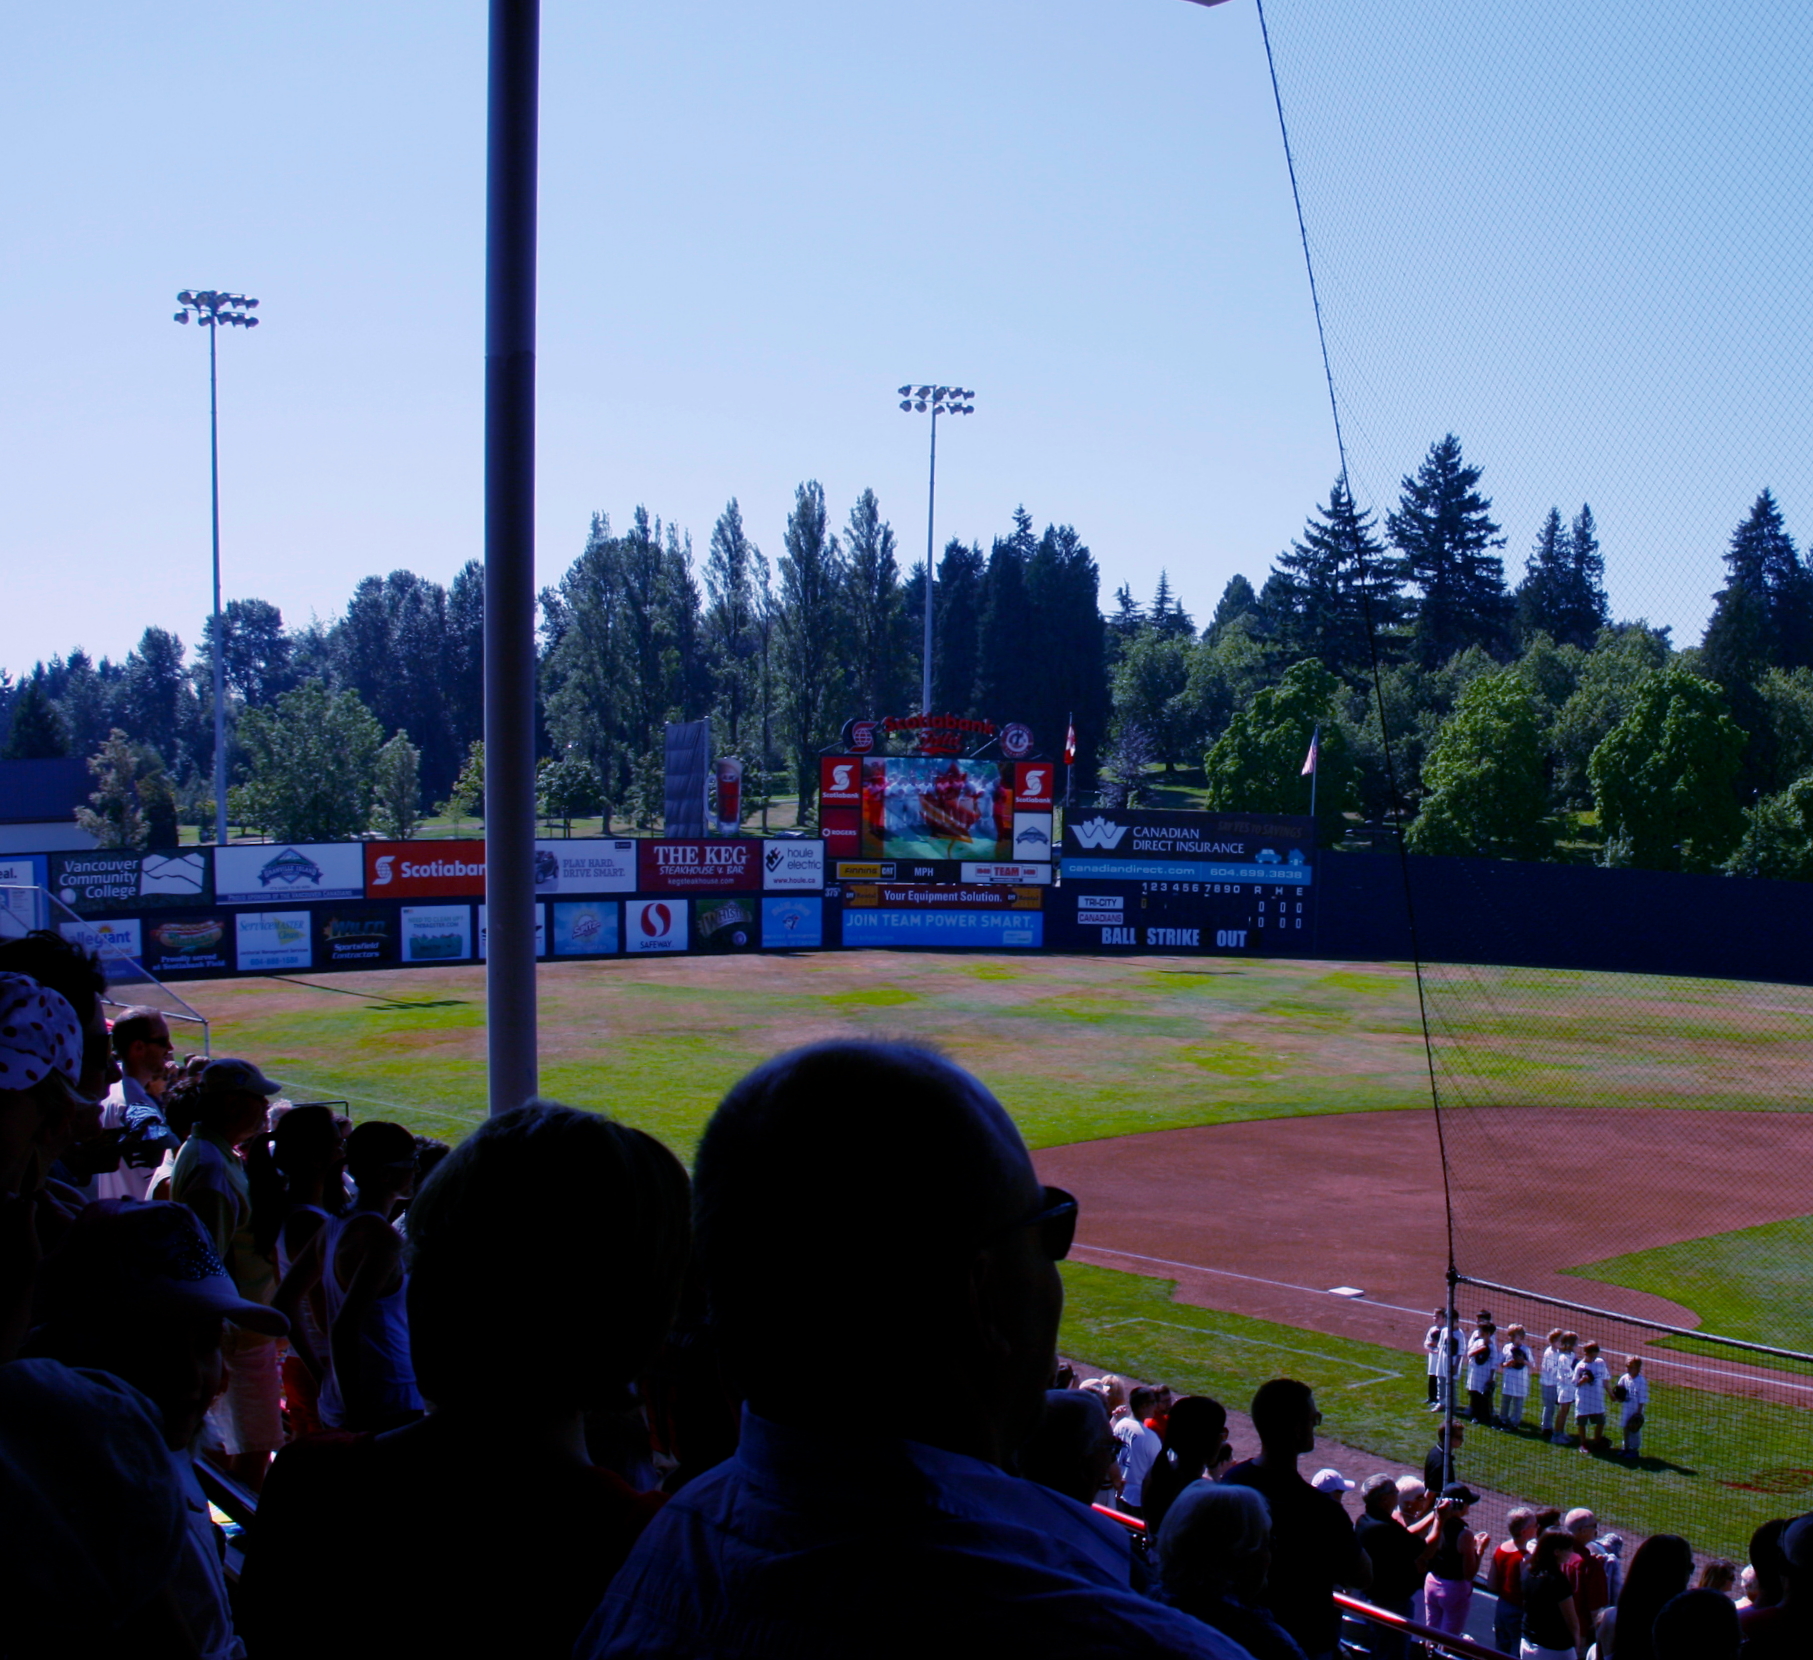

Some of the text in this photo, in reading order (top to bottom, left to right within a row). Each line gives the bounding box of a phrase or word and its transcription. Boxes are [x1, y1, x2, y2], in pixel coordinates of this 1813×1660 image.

[881, 712, 997, 735] Scotiabank
[822, 791, 860, 799] Scotiabank
[1015, 796, 1050, 804] Scotiabank
[831, 829, 858, 837] ROGERS
[1133, 826, 1200, 839] CANADIAN
[1234, 821, 1249, 833] YES
[1262, 824, 1303, 838] SAVINGS
[787, 847, 813, 858] houle
[1133, 840, 1245, 854] DIRECT INSURANCE
[653, 845, 747, 866] THE KEG
[64, 859, 139, 873] Vancouver
[401, 860, 486, 878] Scotiaban
[563, 859, 585, 868] PLAY
[787, 859, 822, 870] electric
[563, 868, 592, 878] DRIVE
[659, 865, 715, 875] STEAKHOUSE
[726, 865, 745, 875] BAR
[881, 865, 894, 876] CAT
[914, 866, 934, 877] MPH
[994, 866, 1019, 876] TEAM
[1069, 864, 1195, 876] canadiandirect.com
[59, 871, 138, 886] Community
[667, 877, 735, 886] kegsteakhouse.com
[85, 885, 137, 900] College
[884, 889, 907, 901] Your
[908, 890, 959, 902] Equipment
[1084, 898, 1117, 907] TRI-CITY
[846, 914, 878, 927] JOIN
[882, 914, 922, 927] TEAM
[926, 914, 977, 928] POWER
[1079, 913, 1122, 923] CANADIANS
[1101, 927, 1247, 947] BALL STRIKE OUT
[333, 941, 380, 952] Sportsfield
[640, 940, 672, 949] SAFEWAY
[331, 951, 380, 960] Contractors
